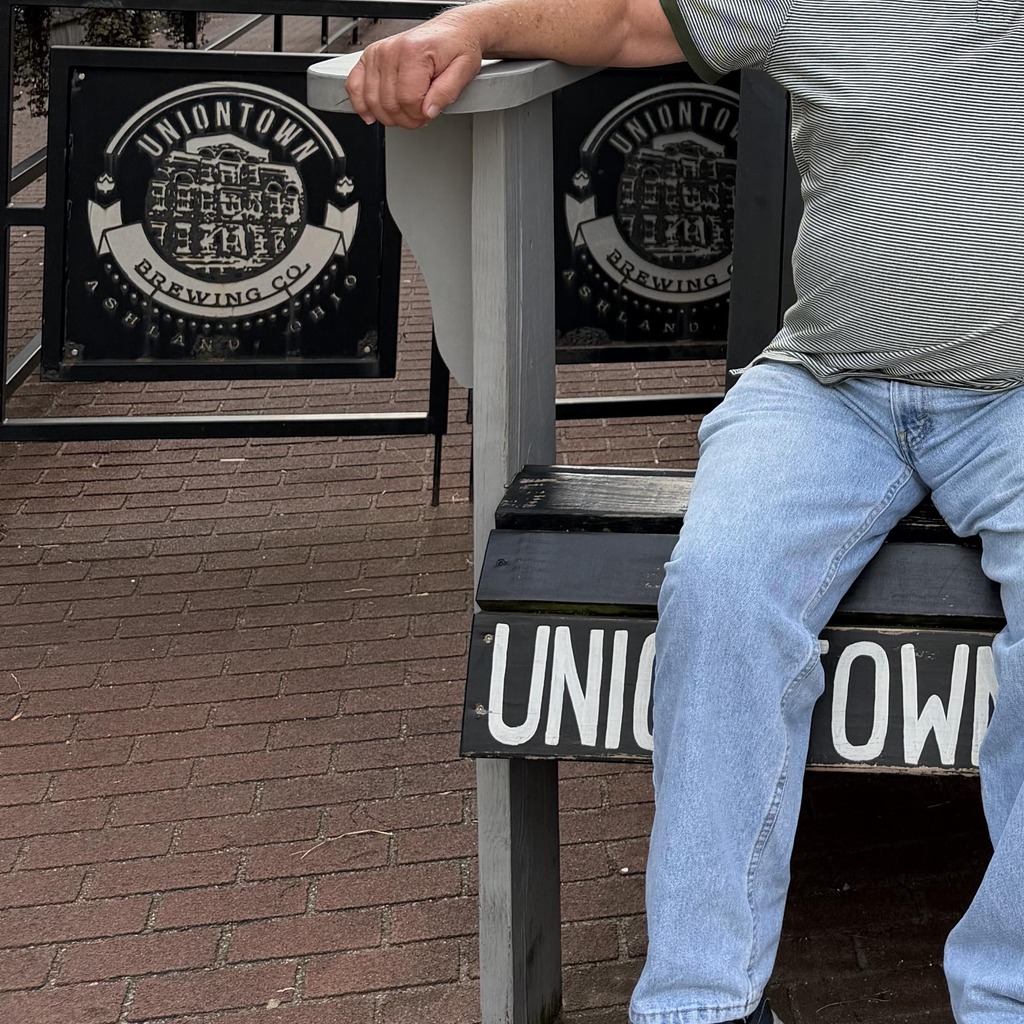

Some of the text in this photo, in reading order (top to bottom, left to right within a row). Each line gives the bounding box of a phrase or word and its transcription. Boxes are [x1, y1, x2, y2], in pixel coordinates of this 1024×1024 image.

[136, 101, 320, 163] UNIONTOWN
[133, 258, 262, 308] BREWING
[605, 248, 719, 294] BREWING
[288, 273, 358, 333] OHIO
